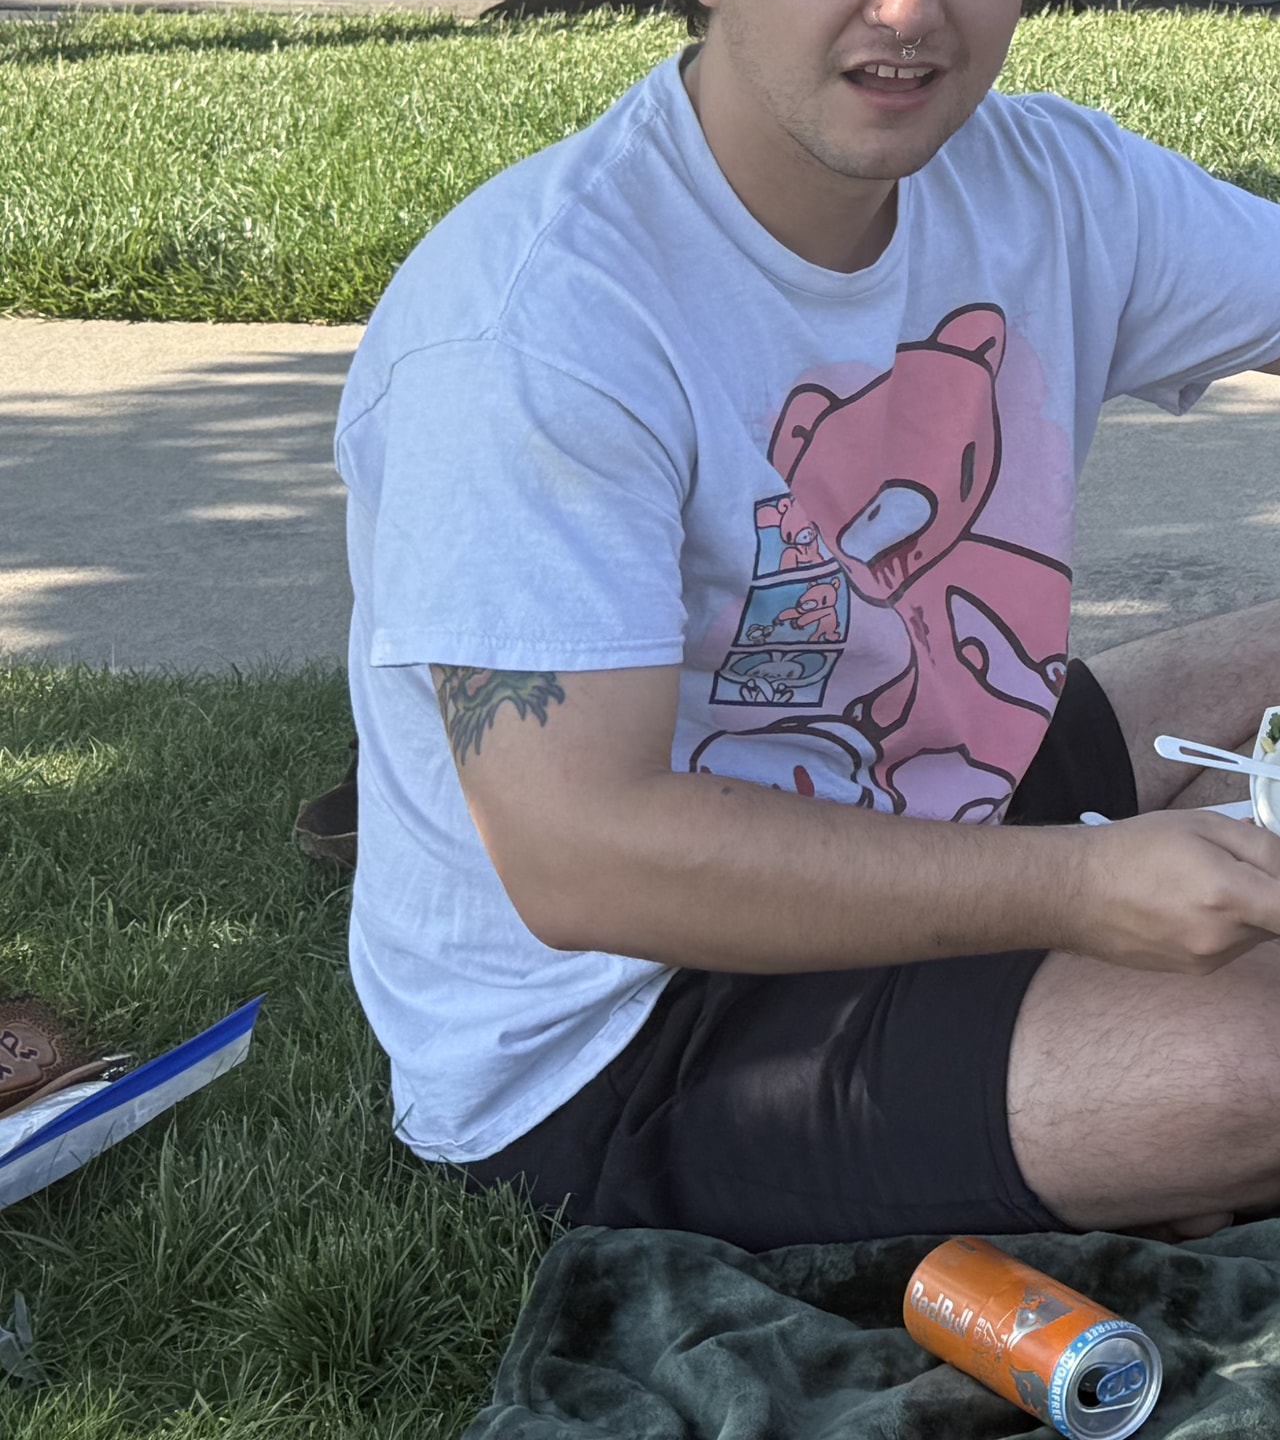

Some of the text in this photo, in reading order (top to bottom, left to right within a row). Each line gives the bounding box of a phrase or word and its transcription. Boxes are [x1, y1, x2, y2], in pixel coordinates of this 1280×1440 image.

[910, 1280, 945, 1322] Red
[938, 1297, 974, 1339] Bull
[1050, 1349, 1077, 1422] SUGARFREE
